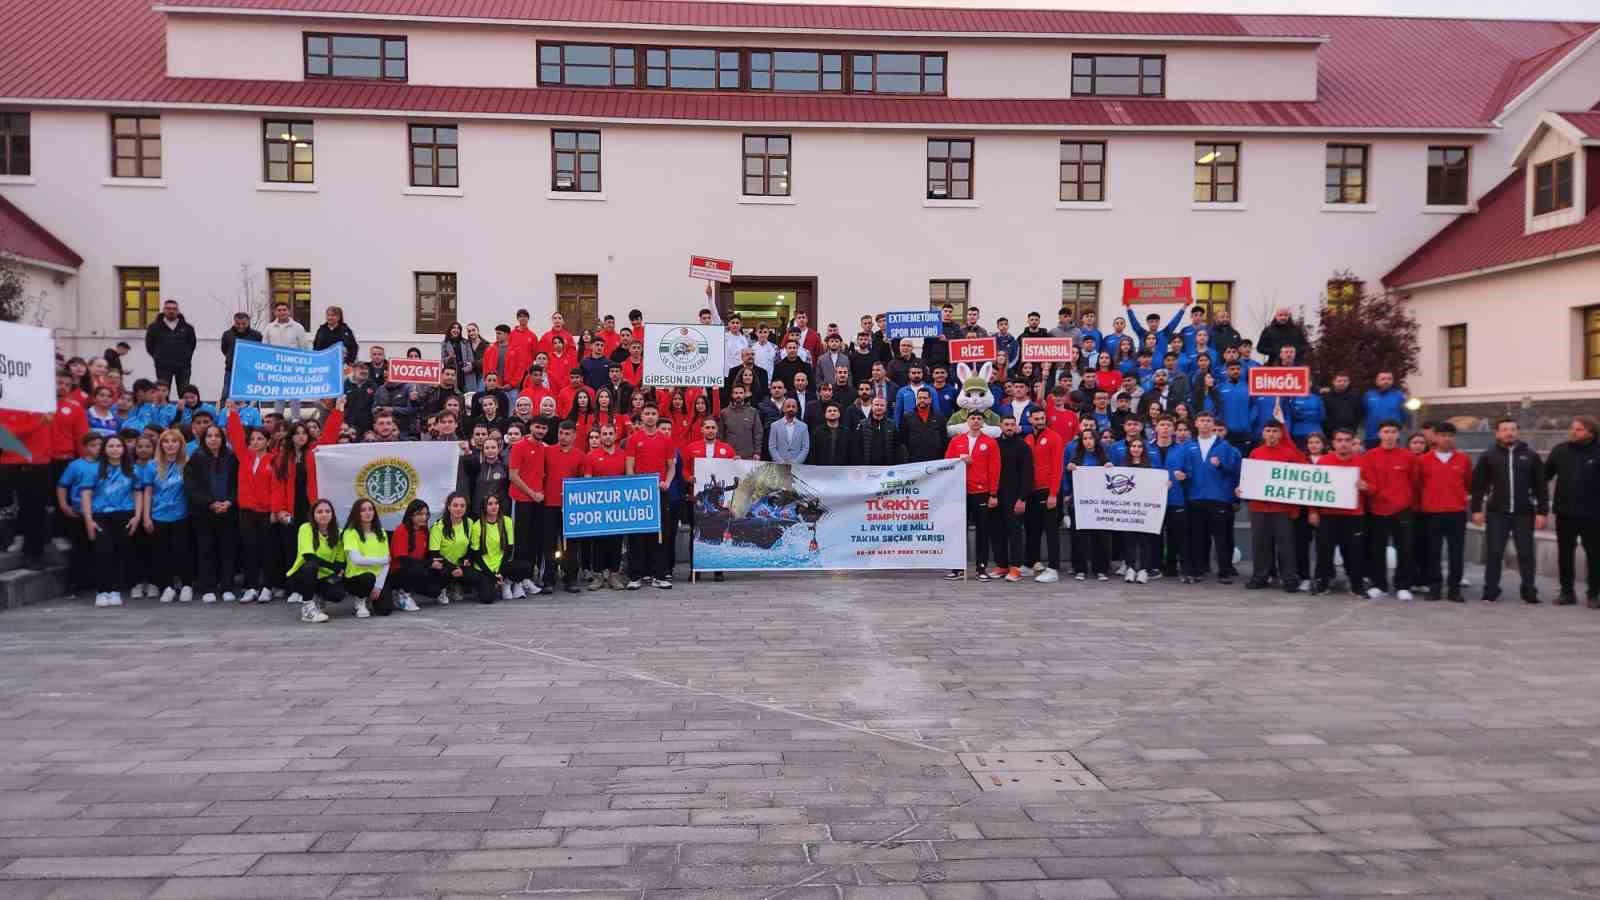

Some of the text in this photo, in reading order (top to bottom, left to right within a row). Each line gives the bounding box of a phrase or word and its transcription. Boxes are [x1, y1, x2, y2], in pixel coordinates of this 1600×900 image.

[888, 312, 939, 323] EXTREMETÜRK
[890, 325, 938, 337] SPOR KULÜBÜ
[961, 344, 985, 357] RİZE
[1025, 343, 1069, 356] İSTANBUL
[0, 353, 32, 379] Spor
[295, 366, 305, 374] VE
[307, 366, 330, 374] SPOR
[392, 364, 439, 378] YOZGAT
[644, 372, 682, 384] GİRESUN
[1255, 373, 1301, 390] BİNGÖL
[246, 383, 330, 396] SPOR KULÜBÜ
[1271, 465, 1331, 484] BİNGÖL
[568, 485, 653, 505] MUNZUR VADİ
[1264, 484, 1336, 502] RAFTİNG
[866, 496, 929, 510] TÜRKİYE
[569, 504, 654, 525] SPOR KULÜBÜ
[870, 523, 894, 531] AYAK
[896, 523, 909, 531] VE
[910, 521, 934, 531] MİLLİ
[851, 534, 945, 543] TAKIM SEÇME YARIŞI
